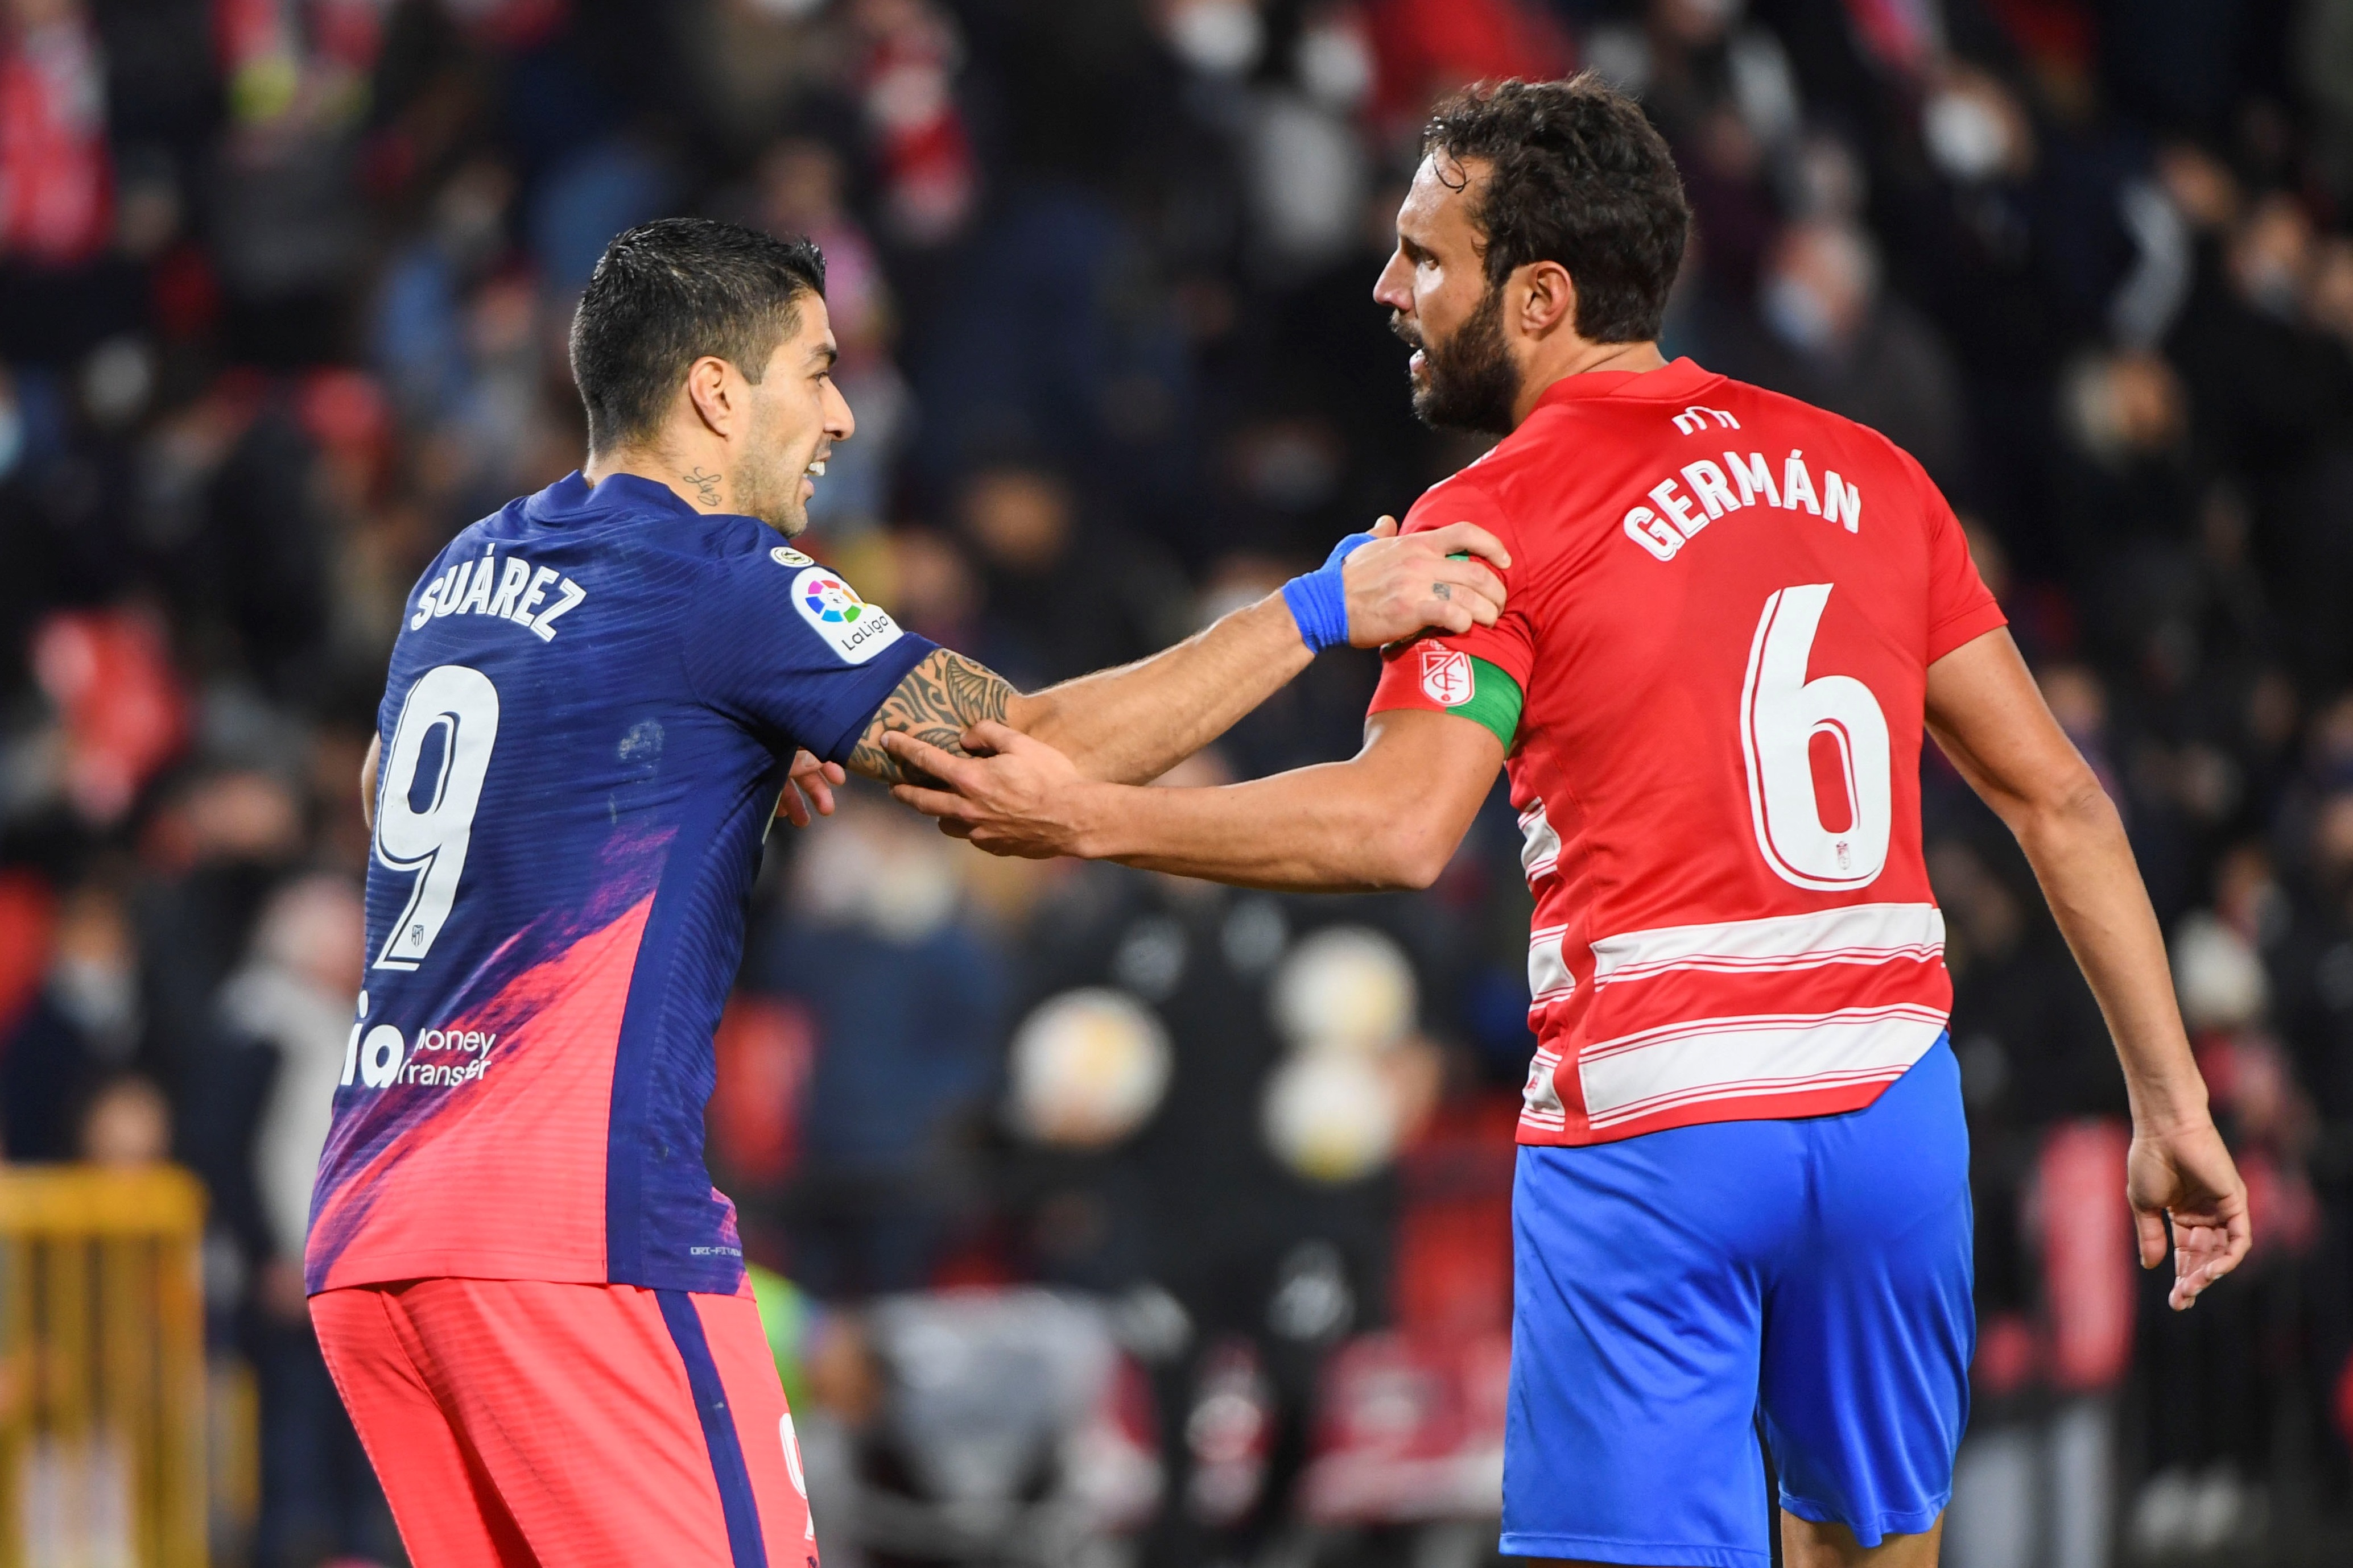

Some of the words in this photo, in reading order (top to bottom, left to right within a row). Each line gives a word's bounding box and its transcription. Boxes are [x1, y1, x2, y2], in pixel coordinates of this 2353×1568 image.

[1623, 449, 1861, 562] GERMÁN
[411, 543, 587, 643] SUÁREZ
[841, 615, 889, 651] LaLiga
[1739, 582, 1891, 892] 6
[371, 664, 500, 971] 9
